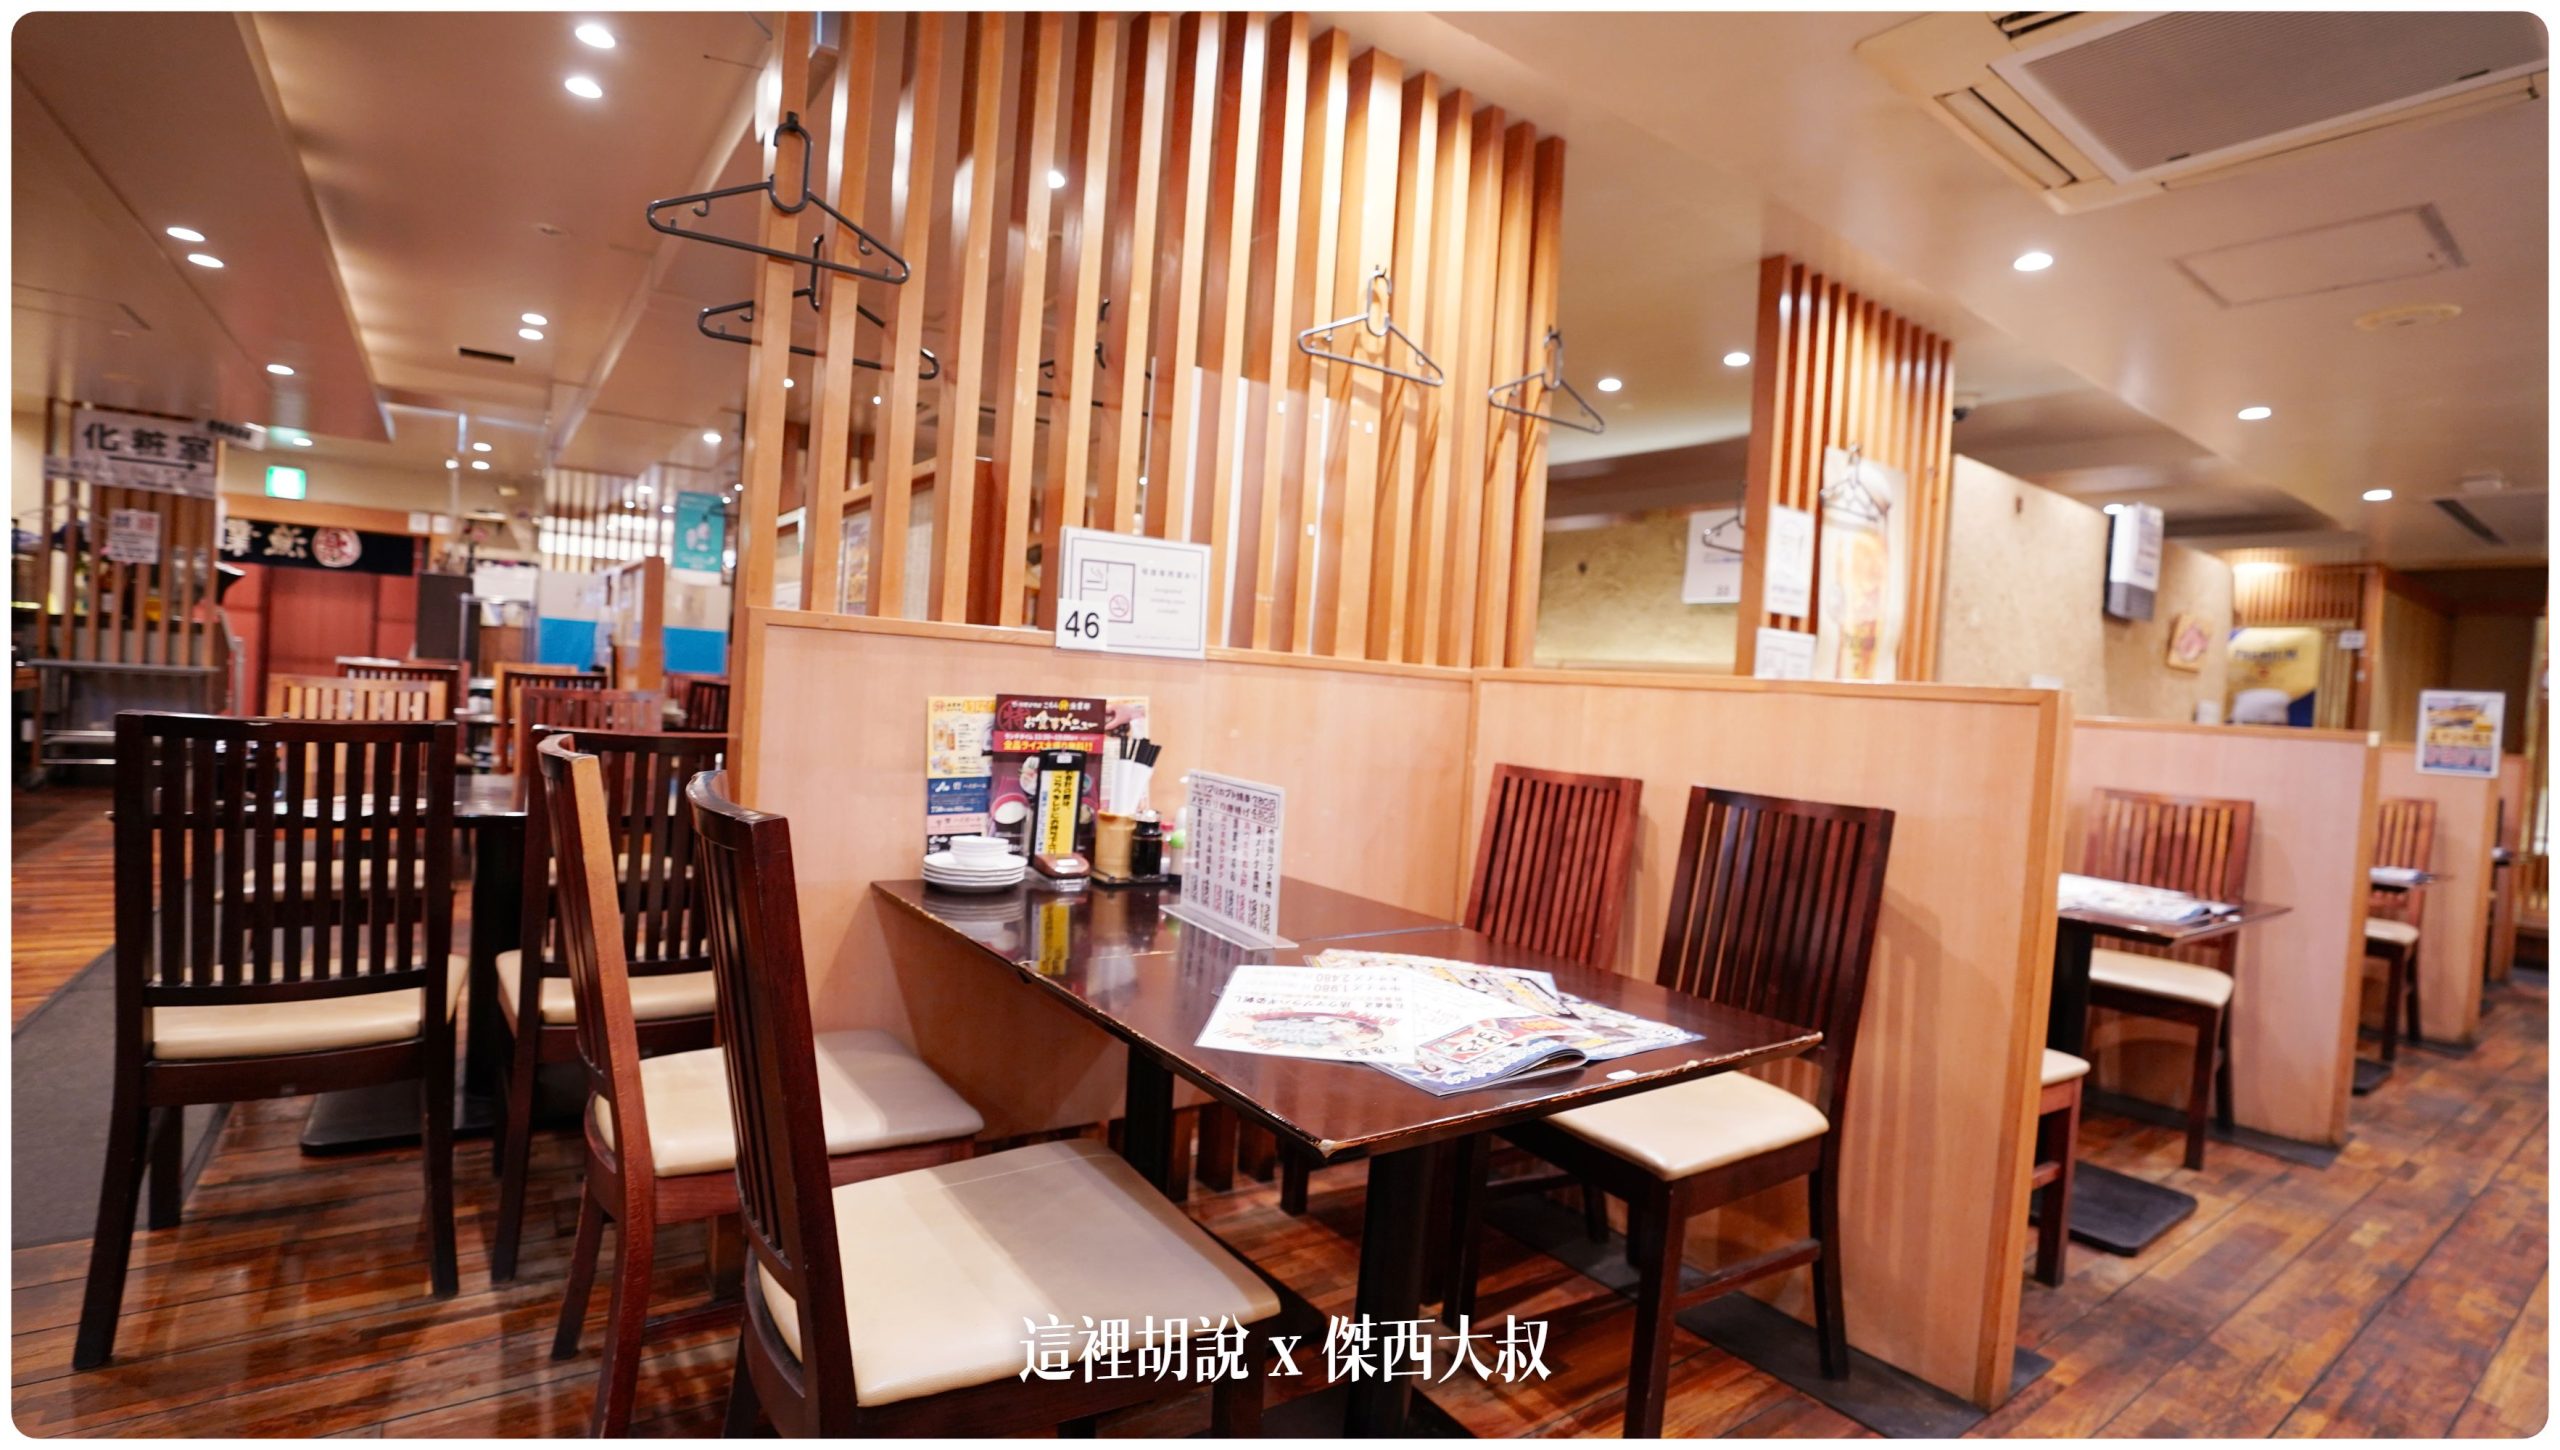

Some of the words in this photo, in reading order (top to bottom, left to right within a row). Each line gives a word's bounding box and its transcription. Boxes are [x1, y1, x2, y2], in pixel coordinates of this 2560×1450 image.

[84, 422, 211, 462] 化粧室
[1065, 610, 1100, 639] 46
